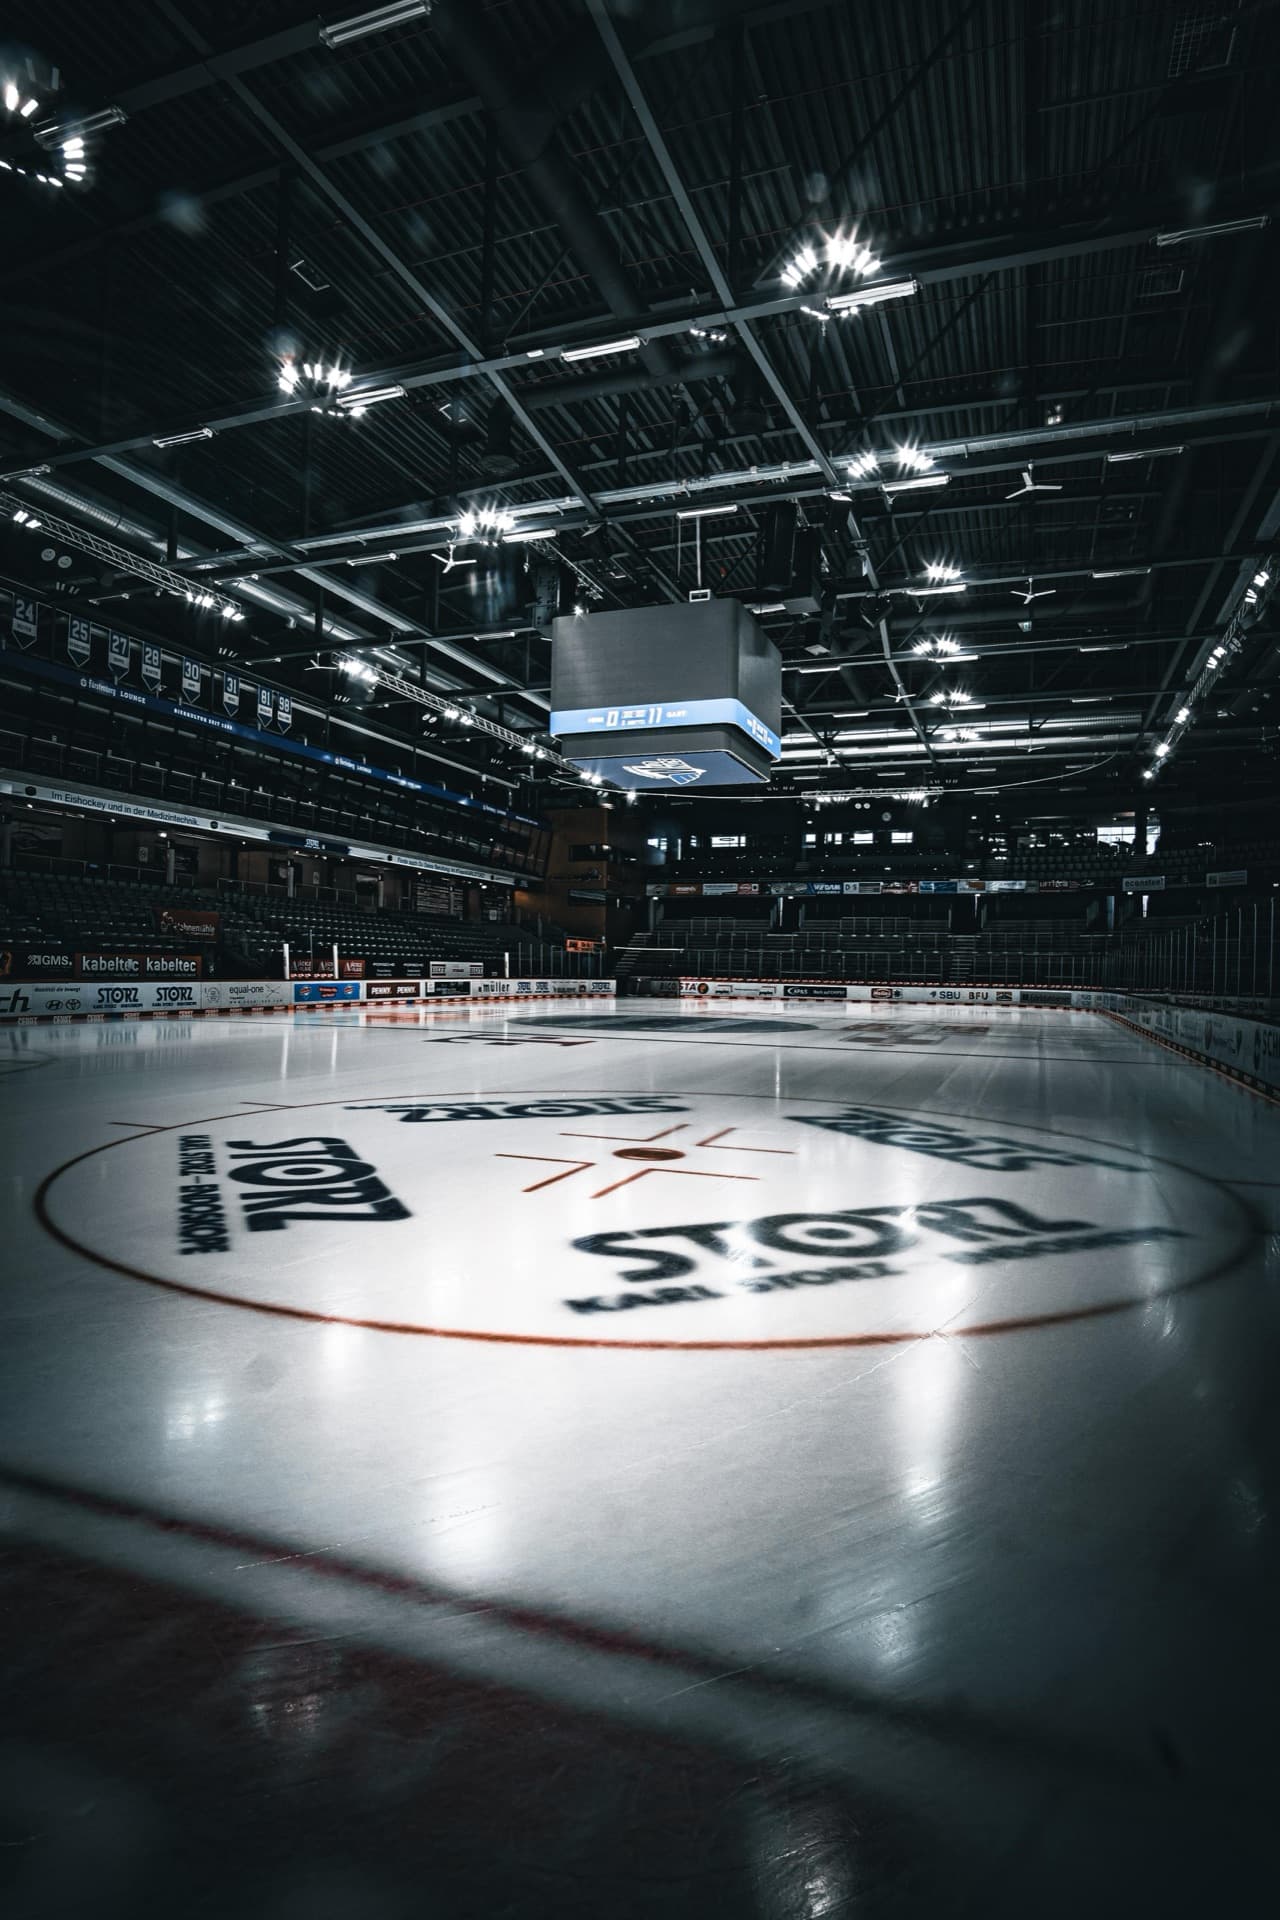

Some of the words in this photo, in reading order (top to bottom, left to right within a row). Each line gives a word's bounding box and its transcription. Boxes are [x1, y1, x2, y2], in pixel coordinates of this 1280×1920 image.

[15, 599, 34, 622] 24
[71, 620, 89, 641] 25
[112, 635, 127, 655] 27
[145, 647, 160, 666] 28
[184, 663, 199, 680] 30
[226, 678, 237, 694] 31
[120, 690, 146, 704] LOUNGE
[261, 690, 271, 705] 81
[279, 697, 290, 712] 98
[51, 791, 63, 800] Im
[65, 793, 106, 809] Eishockey
[107, 802, 123, 812] und
[124, 805, 132, 813] in
[133, 806, 146, 816] der
[82, 955, 139, 972] kabeltec
[146, 956, 197, 972] kabeltec
[97, 986, 139, 1003] STORZ
[156, 986, 193, 1001] STORZ
[229, 984, 264, 996] equal-one
[938, 990, 961, 1000] SBU
[968, 991, 989, 1000] BFU
[178, 1152, 217, 1177] STORZ
[225, 1136, 413, 1233] STORZ
[178, 1183, 231, 1256] ENDOSKOPE
[570, 1197, 1098, 1283] STORZ
[739, 1261, 908, 1293] STORZ
